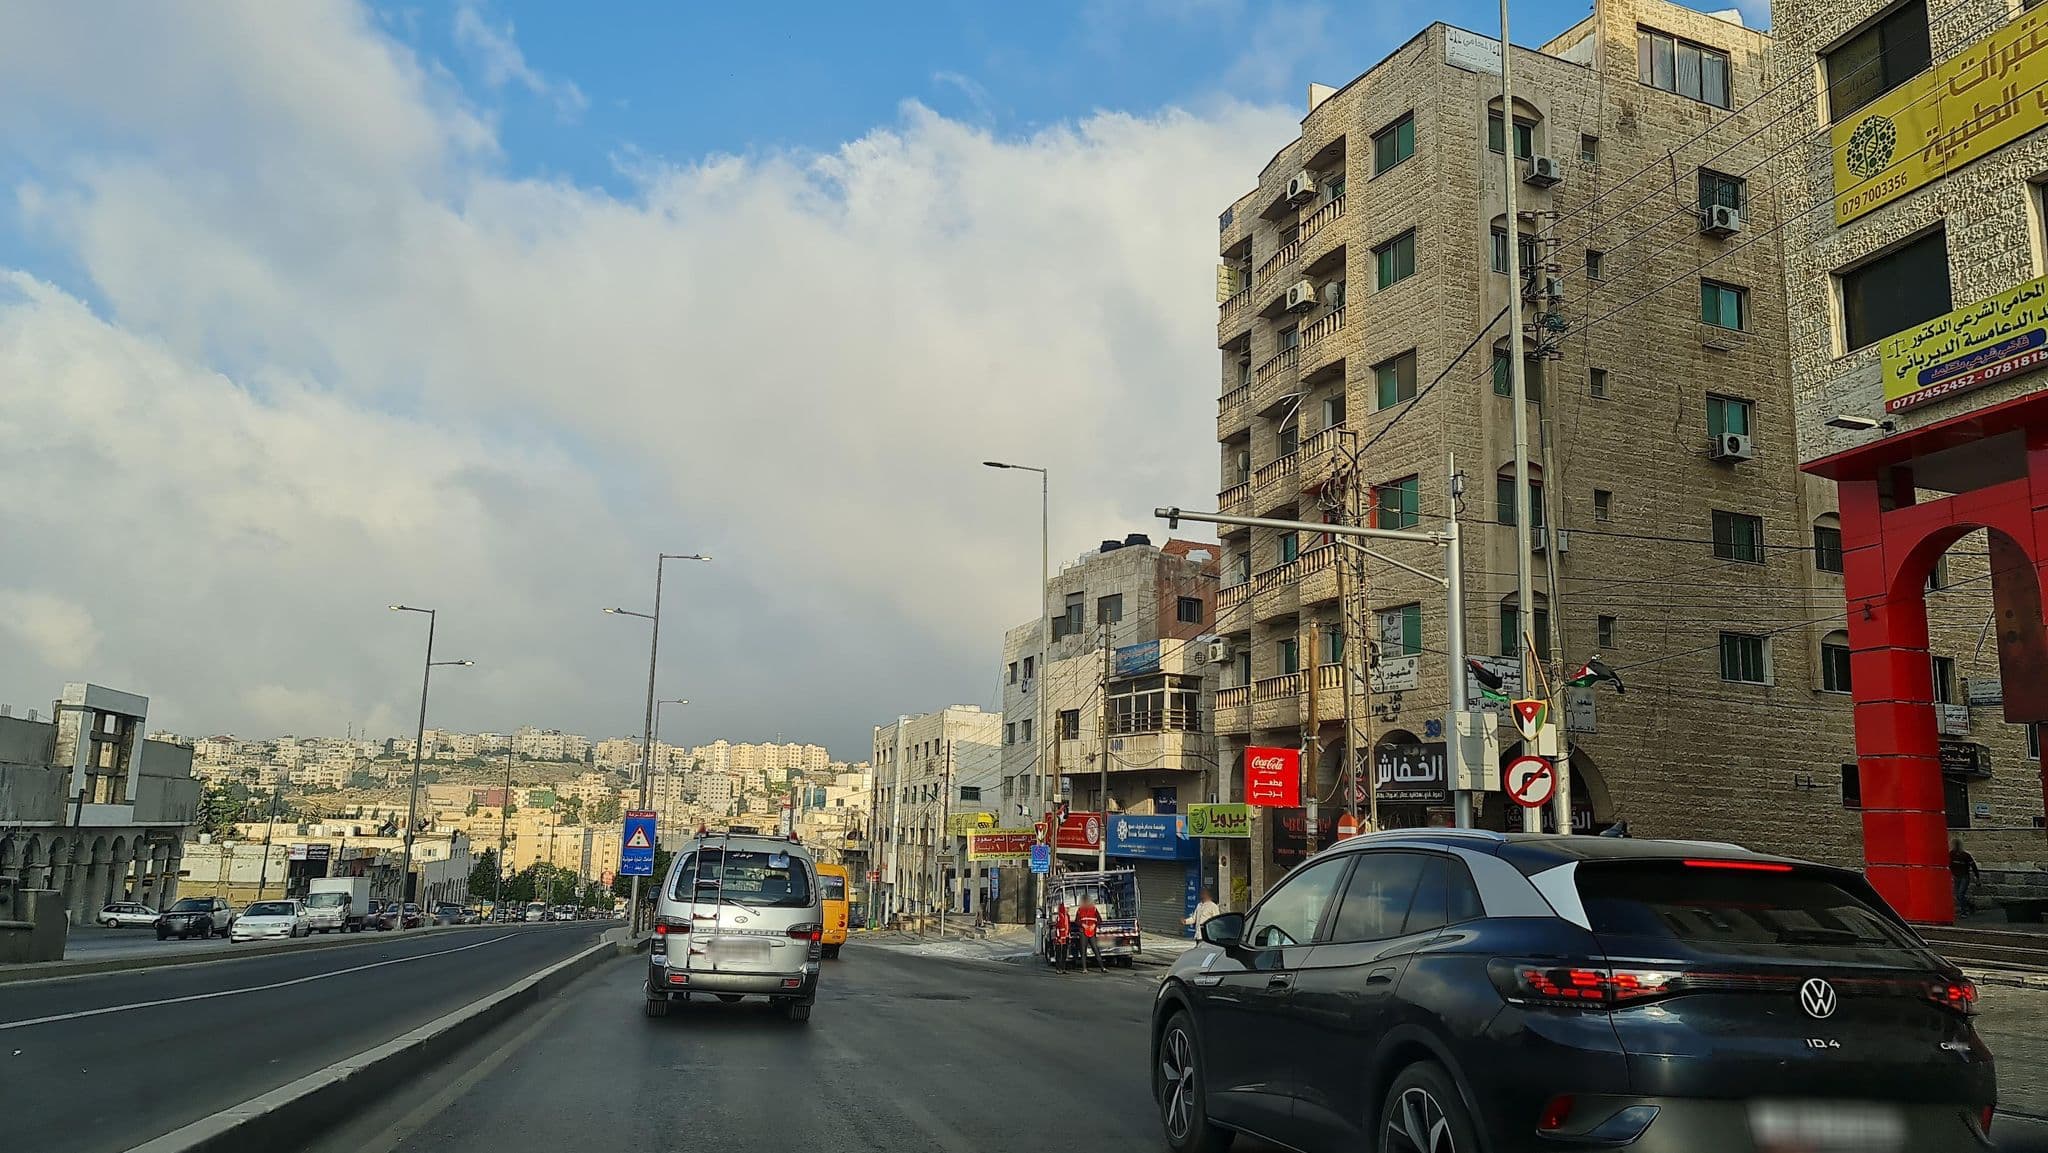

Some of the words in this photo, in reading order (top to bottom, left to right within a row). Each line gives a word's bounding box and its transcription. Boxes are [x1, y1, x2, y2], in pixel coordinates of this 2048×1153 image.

[1949, 17, 2048, 97] تبرات
[2001, 282, 2045, 316] المحامي
[1910, 319, 1952, 349] الدكتور
[1954, 300, 2000, 335] الشرعي
[1892, 375, 1975, 410] 0772452452
[1375, 753, 1443, 789] الخفاش
